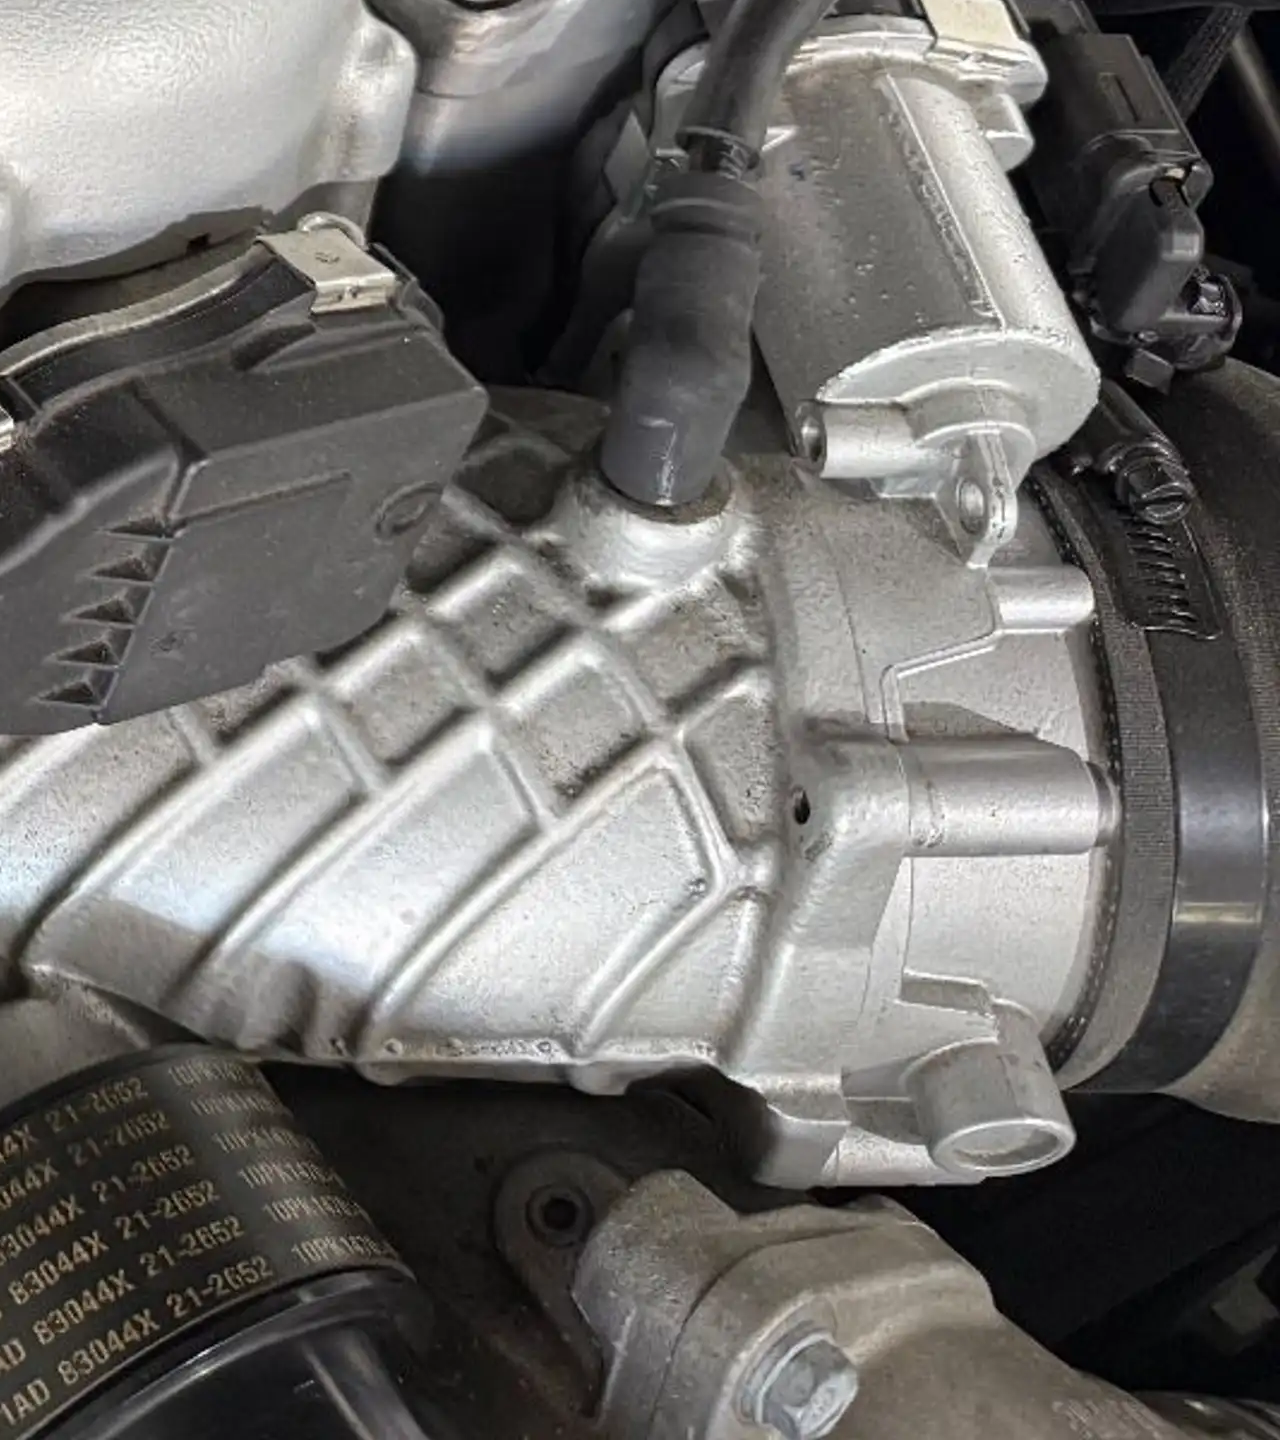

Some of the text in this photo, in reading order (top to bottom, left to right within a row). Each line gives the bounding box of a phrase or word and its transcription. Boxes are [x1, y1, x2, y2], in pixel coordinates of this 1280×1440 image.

[8, 1230, 110, 1305] 83044X
[115, 1179, 221, 1241] 21-2652
[32, 1268, 136, 1345] 83044X
[139, 1215, 245, 1277] 21-2652
[57, 1309, 160, 1386] 83044X
[166, 1255, 275, 1318] 21-2652
